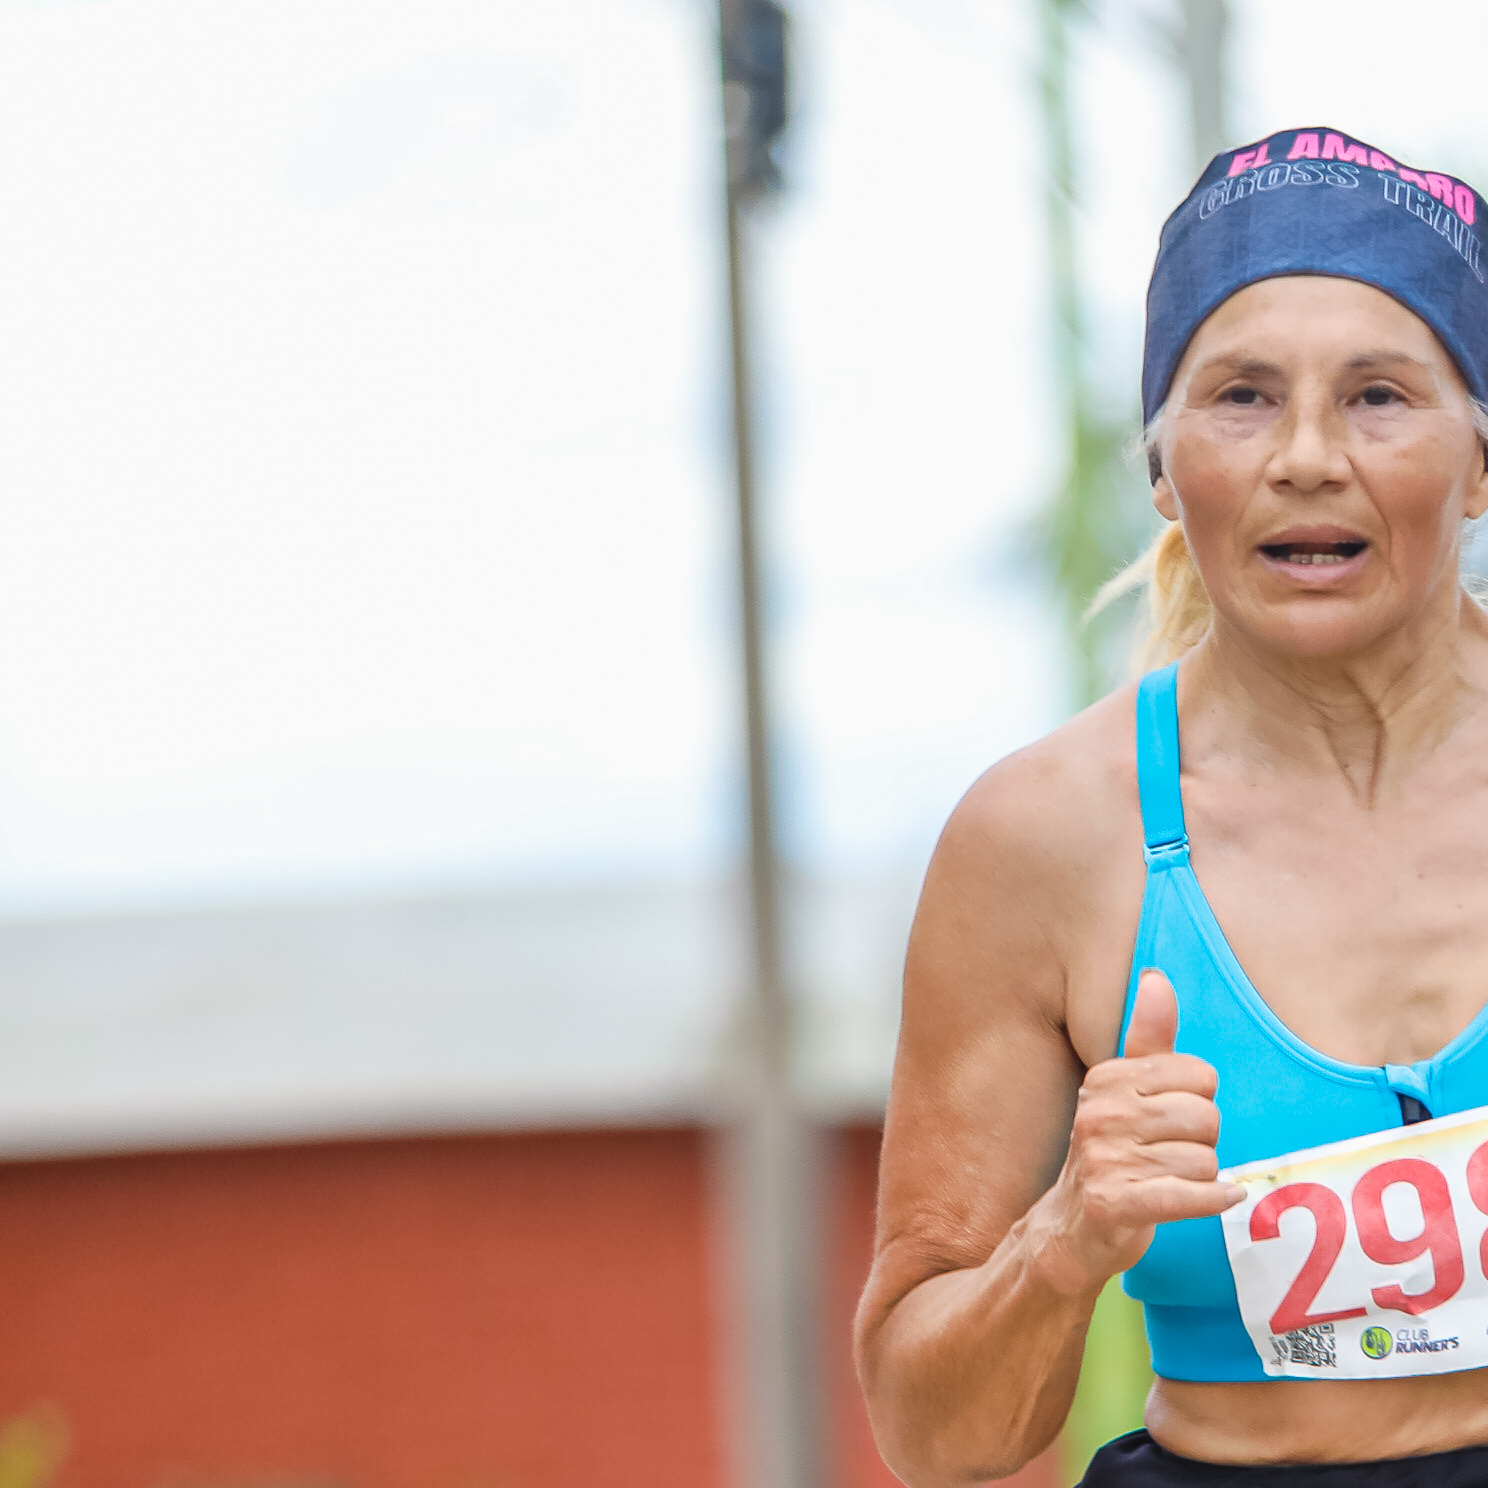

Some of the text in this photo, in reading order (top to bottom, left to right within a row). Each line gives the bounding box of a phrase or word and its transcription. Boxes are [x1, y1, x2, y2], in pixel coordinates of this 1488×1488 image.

[1227, 143, 1272, 177] EL
[1200, 160, 1360, 220] CROSS
[1396, 1328, 1430, 1342] CLUB
